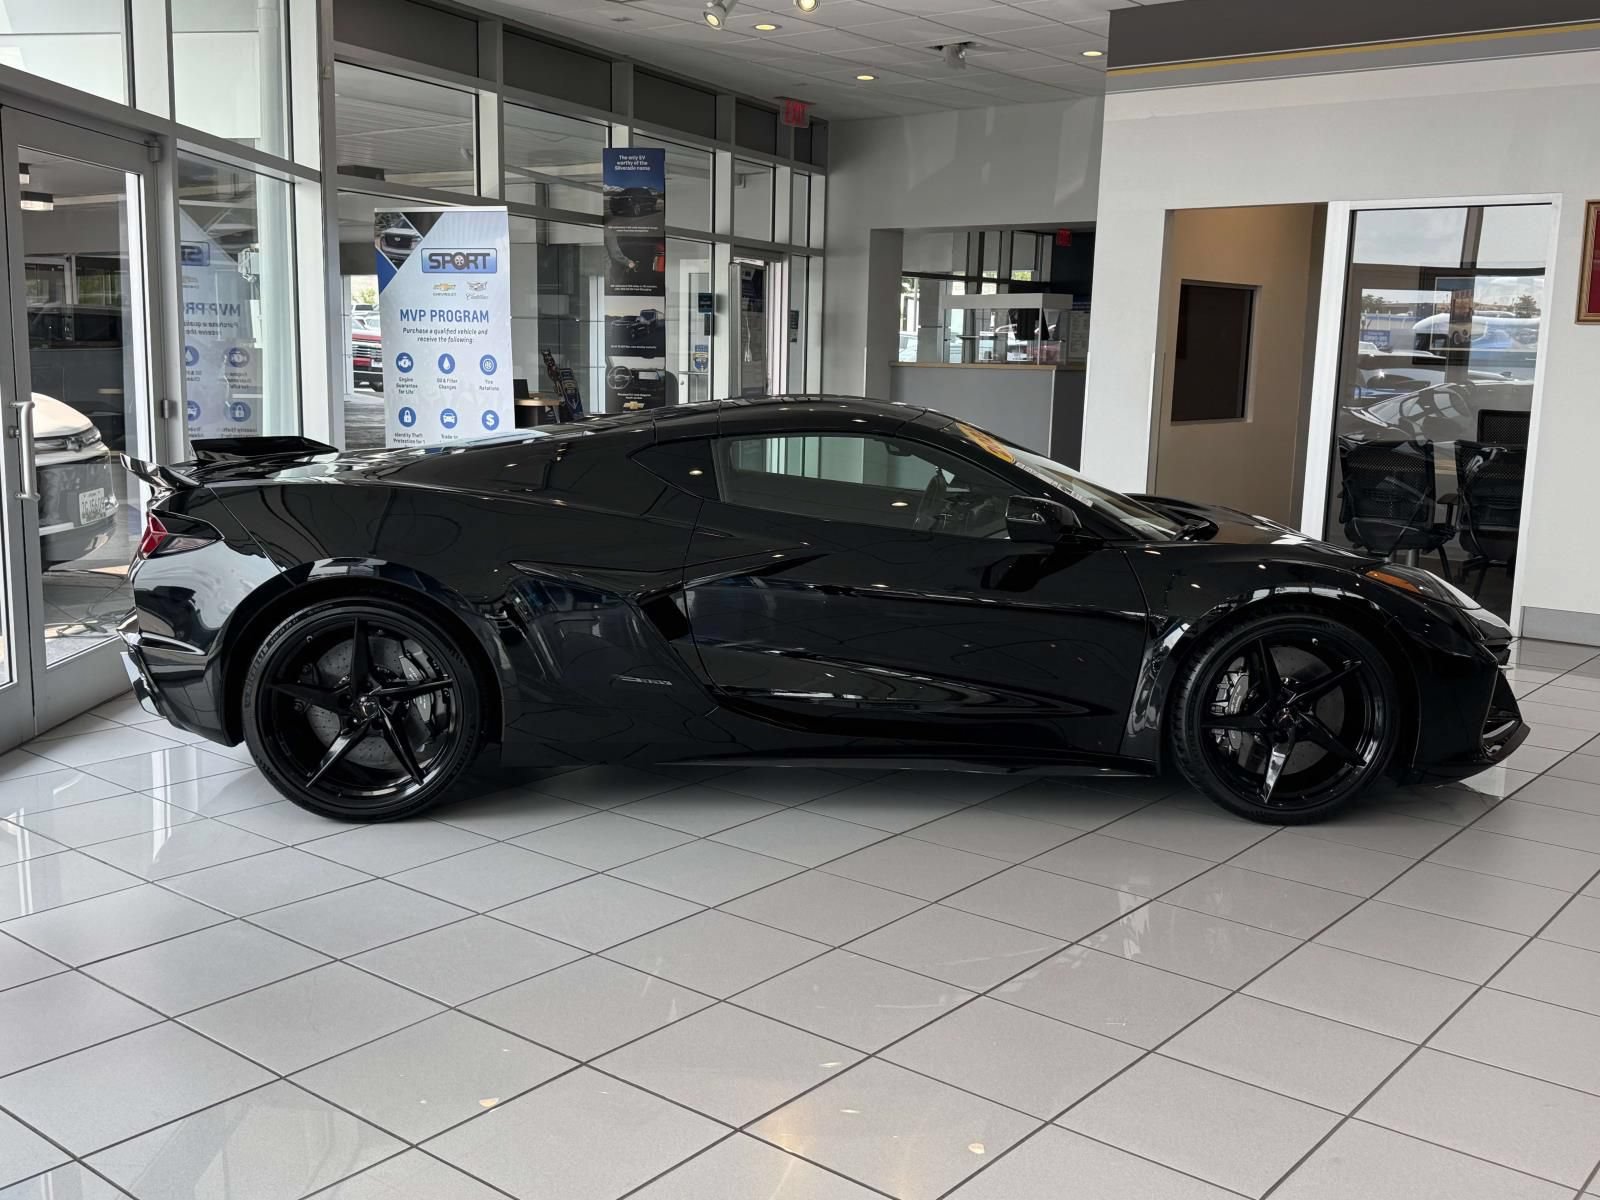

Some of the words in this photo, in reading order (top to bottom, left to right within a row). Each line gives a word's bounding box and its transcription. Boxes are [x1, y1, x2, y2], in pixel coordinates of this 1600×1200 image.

[428, 251, 491, 271] SPORT
[400, 308, 427, 322] MVP
[430, 309, 490, 324] PROGRAM
[402, 327, 429, 335] Purchase
[434, 328, 457, 336] qualified
